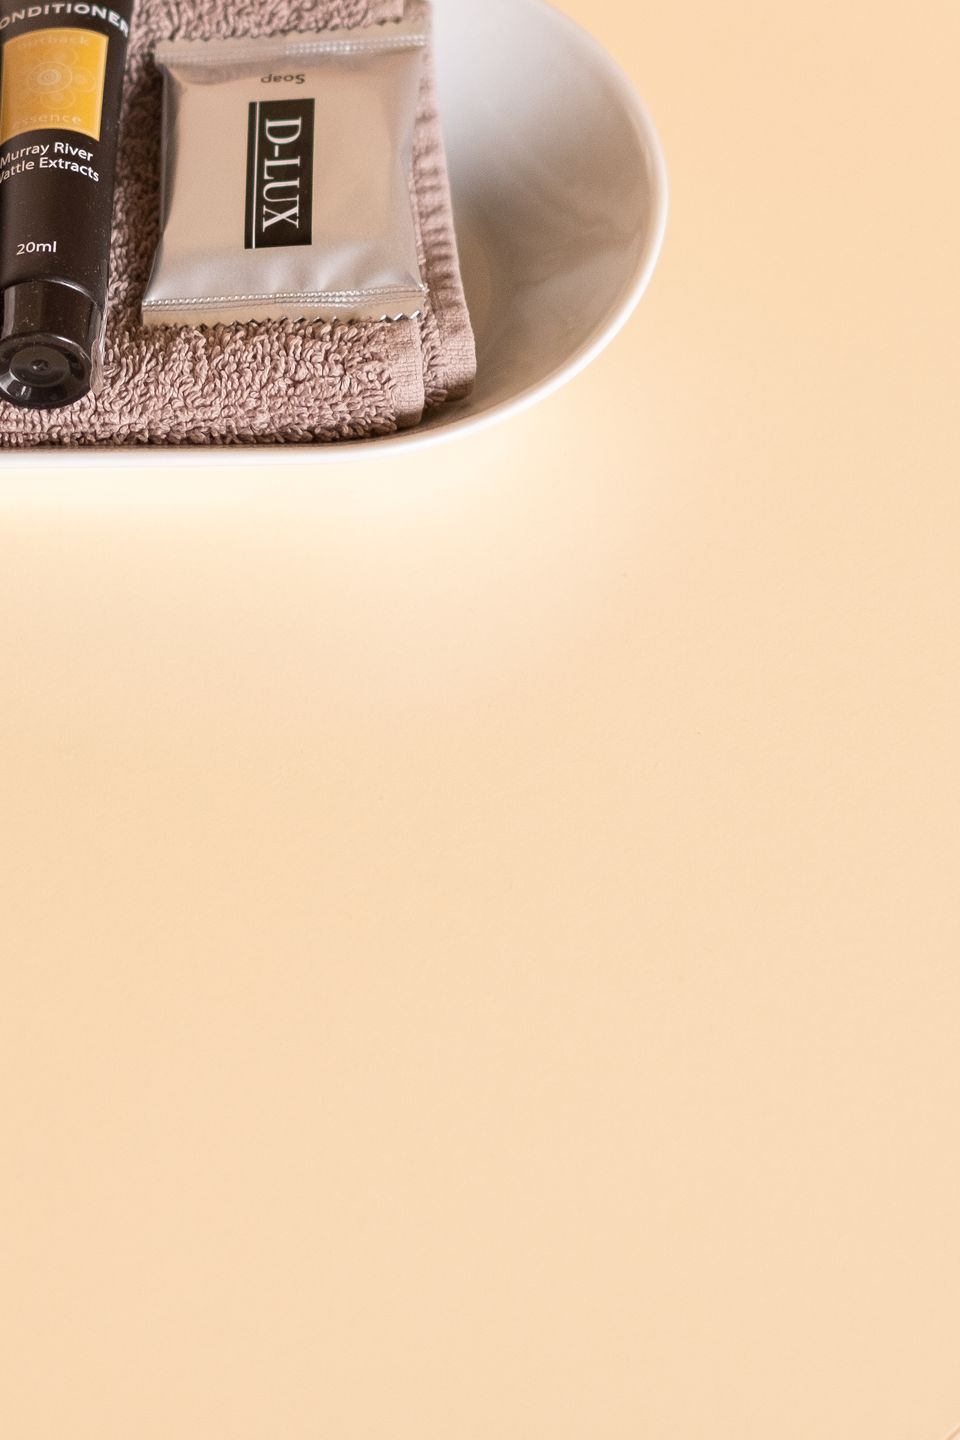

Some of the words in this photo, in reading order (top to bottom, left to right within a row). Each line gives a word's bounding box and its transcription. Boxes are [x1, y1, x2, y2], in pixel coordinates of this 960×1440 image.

[260, 73, 306, 84] Soap
[0, 143, 50, 169] Murray
[54, 142, 93, 161] River
[39, 157, 100, 182] Extracts
[262, 116, 302, 232] D-LUX
[16, 241, 57, 256] 20ml
